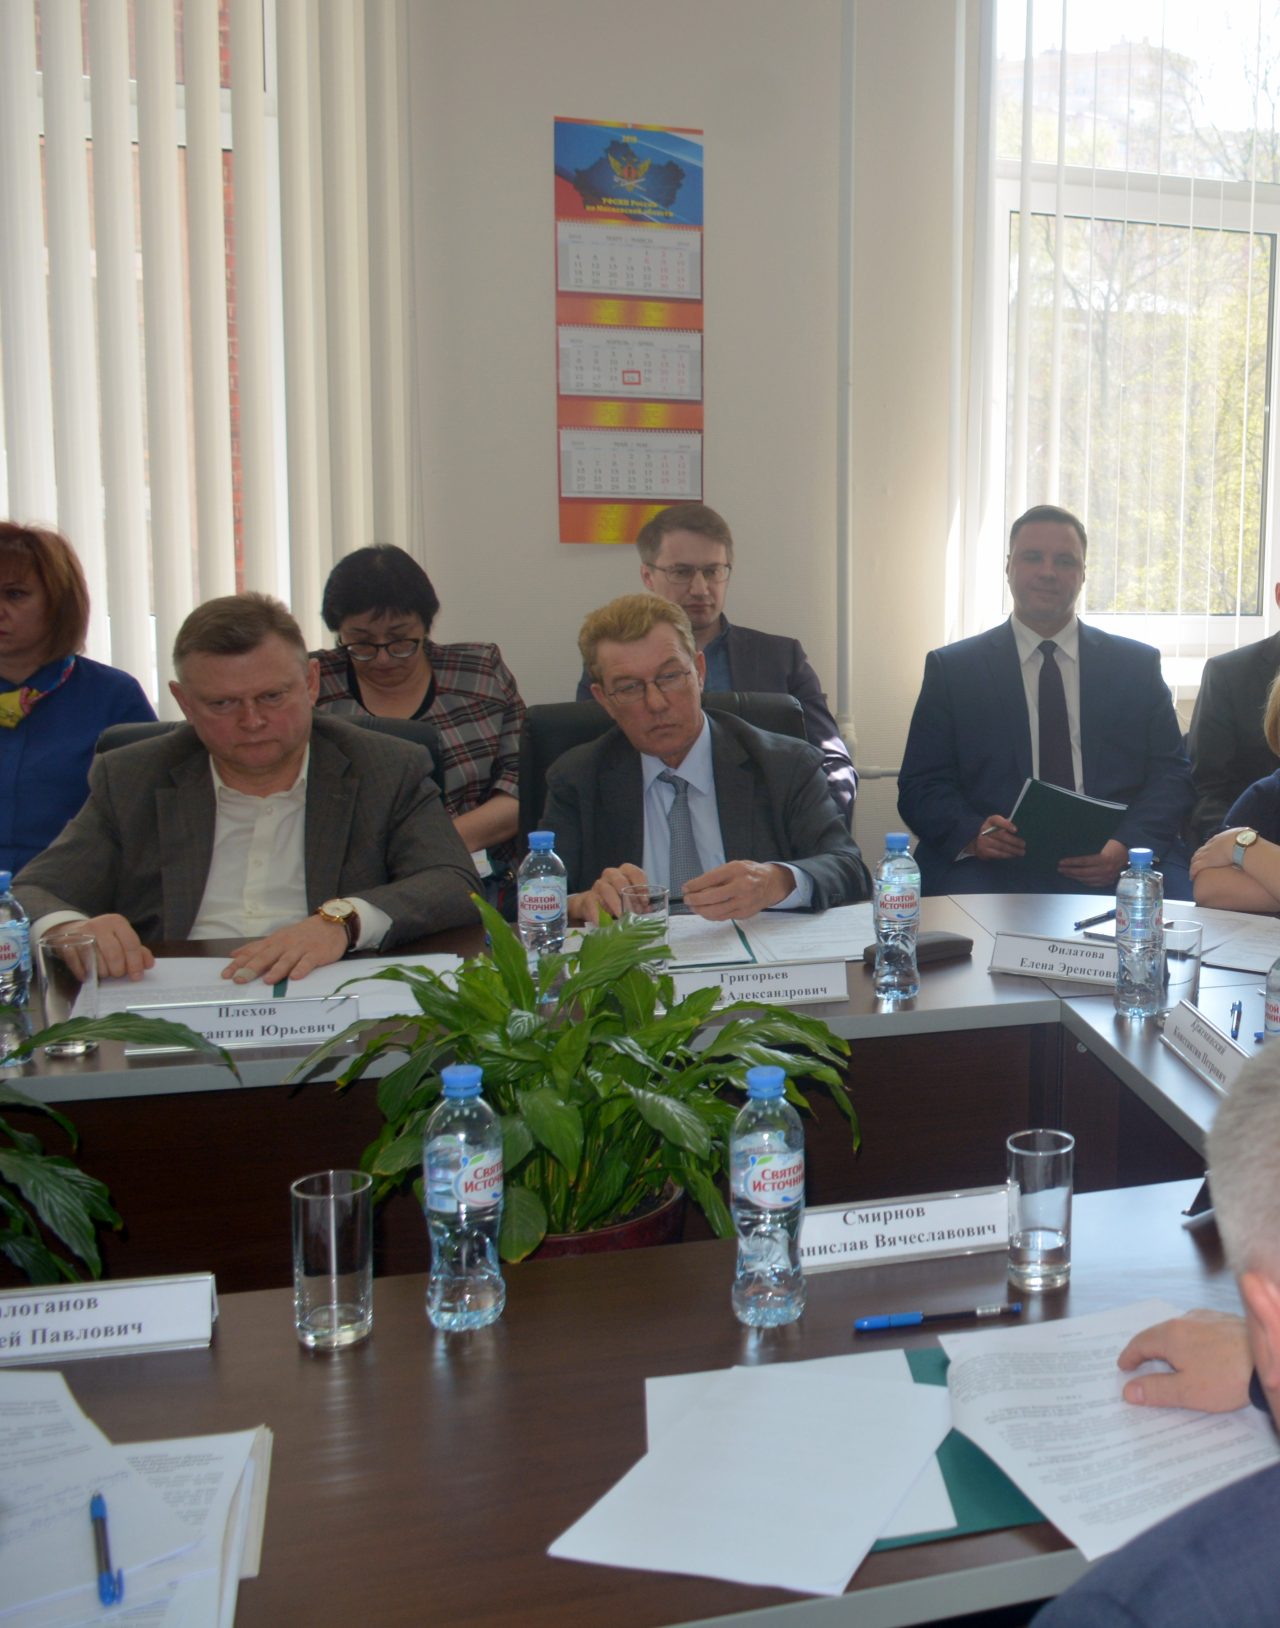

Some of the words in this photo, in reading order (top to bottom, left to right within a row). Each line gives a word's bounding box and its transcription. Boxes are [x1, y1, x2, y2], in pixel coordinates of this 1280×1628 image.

[1048, 944, 1104, 960] Филатова
[1020, 957, 1054, 971] Елена
[720, 972, 789, 984] Григорьев
[728, 986, 828, 1002] Александрович
[218, 1006, 277, 1018] Плехов
[261, 1022, 336, 1038] Юрьевич
[842, 1206, 926, 1226] Смирнов
[874, 1224, 997, 1248] Вячеславович
[31, 1322, 143, 1346] Павлович
